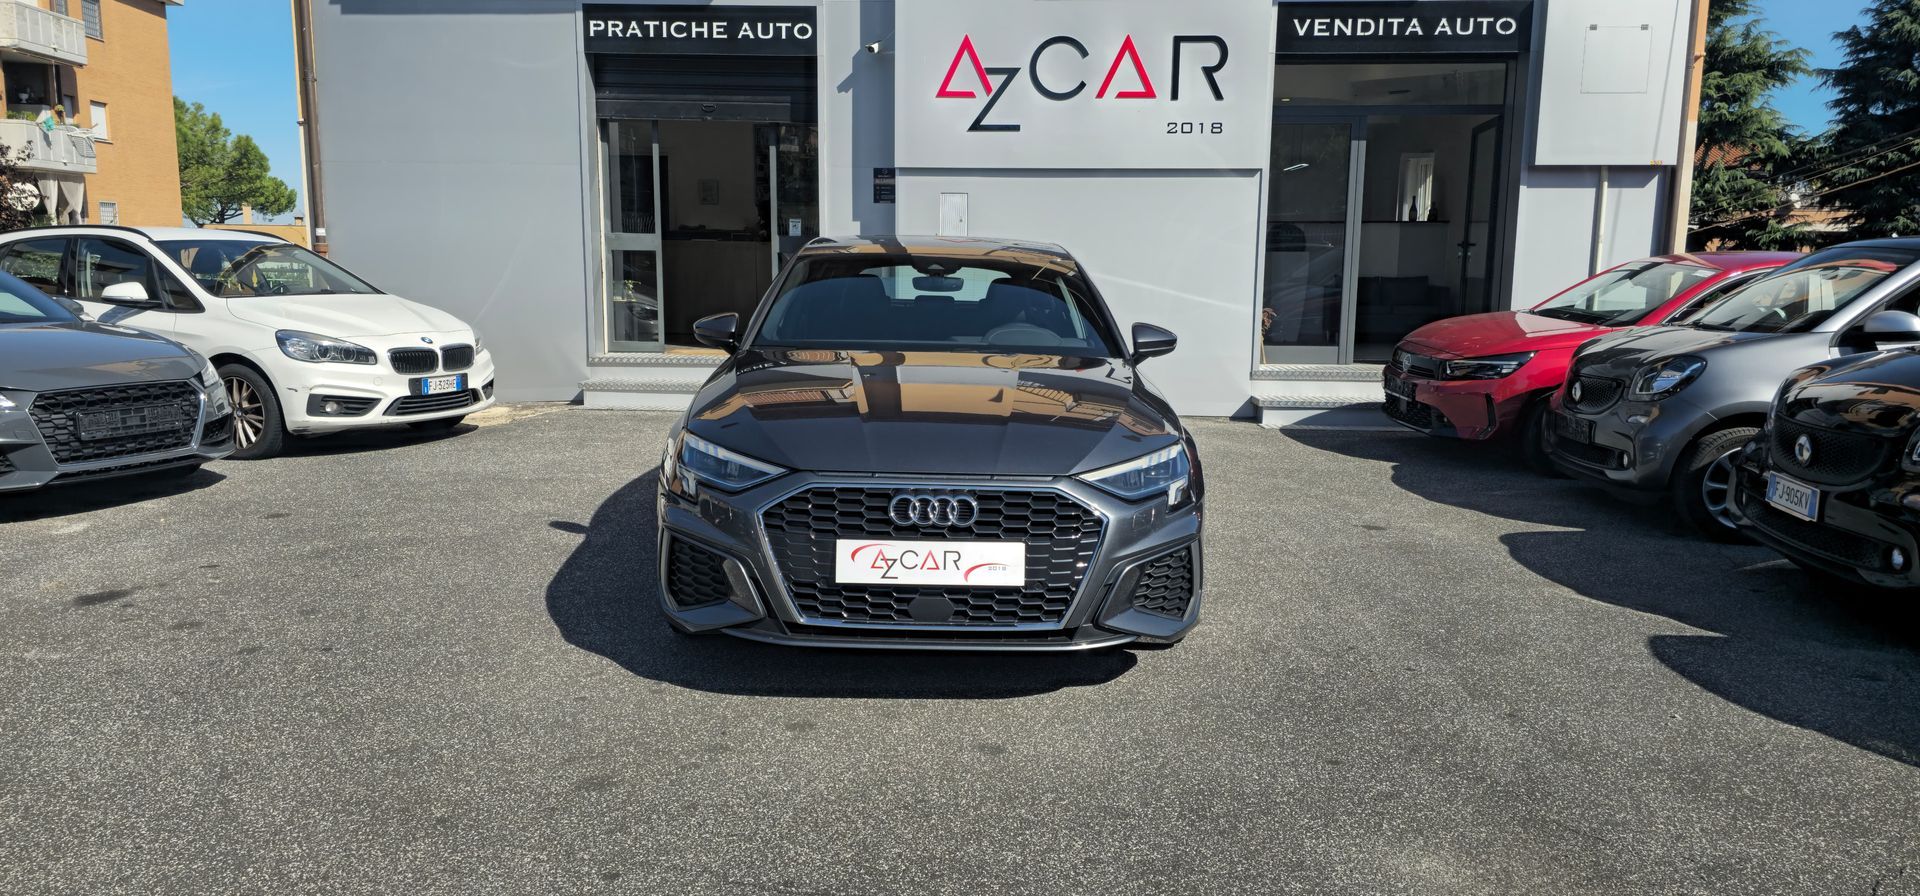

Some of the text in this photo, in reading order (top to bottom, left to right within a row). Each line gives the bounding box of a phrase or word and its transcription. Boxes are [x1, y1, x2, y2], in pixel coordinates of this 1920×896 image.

[589, 20, 813, 40] PRATICHE AUTO
[1293, 17, 1517, 37] VENDITA AUTO
[1166, 122, 1223, 135] 2018
